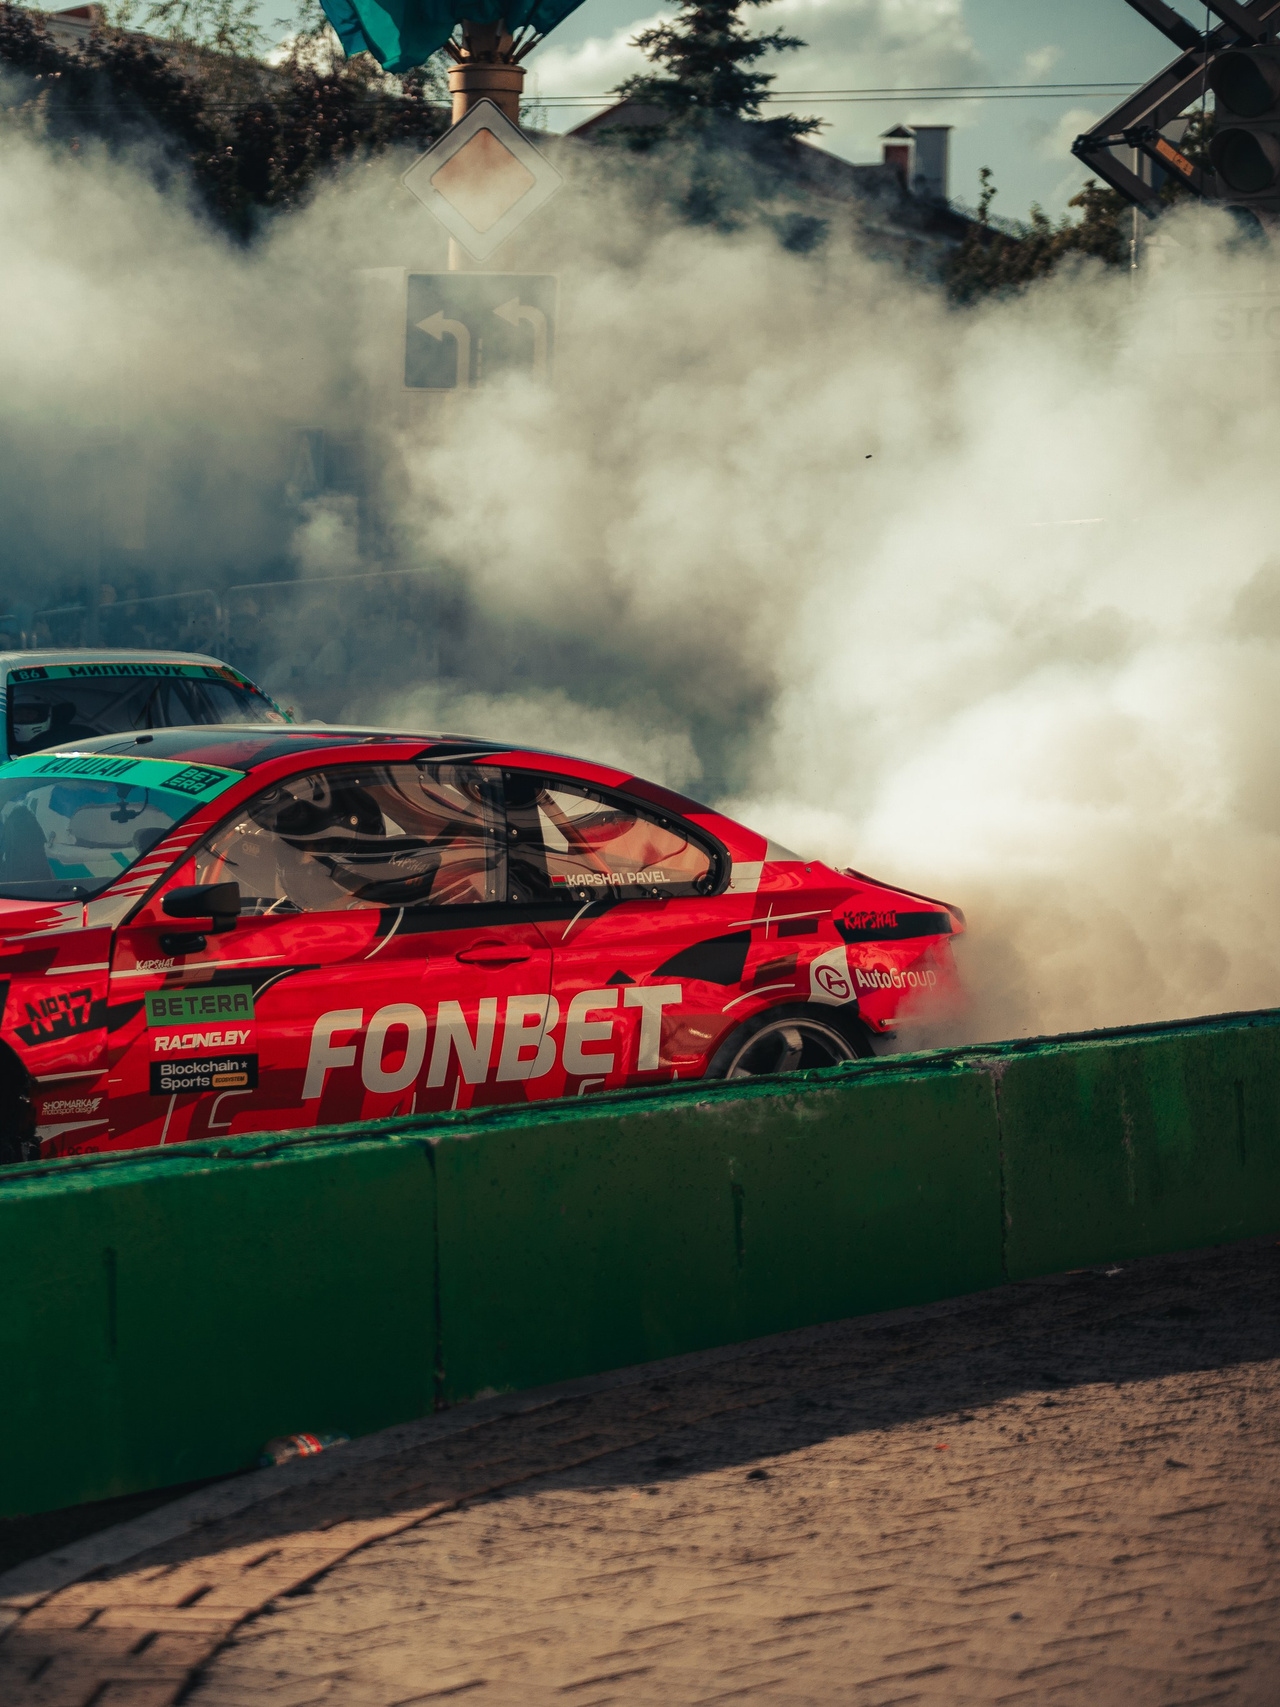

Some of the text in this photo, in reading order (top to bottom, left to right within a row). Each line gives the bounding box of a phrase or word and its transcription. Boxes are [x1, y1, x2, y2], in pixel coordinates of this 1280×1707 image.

[19, 669, 41, 680] 86
[181, 768, 221, 783] BET
[567, 871, 671, 886] KAPSHAI PAVEL
[843, 909, 898, 930] KAPSHAI
[855, 968, 937, 991] AutoGroup
[154, 1029, 251, 1052] RACING.BY
[301, 984, 684, 1100] FONBET
[160, 1060, 239, 1076] Blockchain
[160, 1075, 245, 1090] Sports ECOSYSTEM
[42, 1099, 92, 1110] SHOPMARKA
